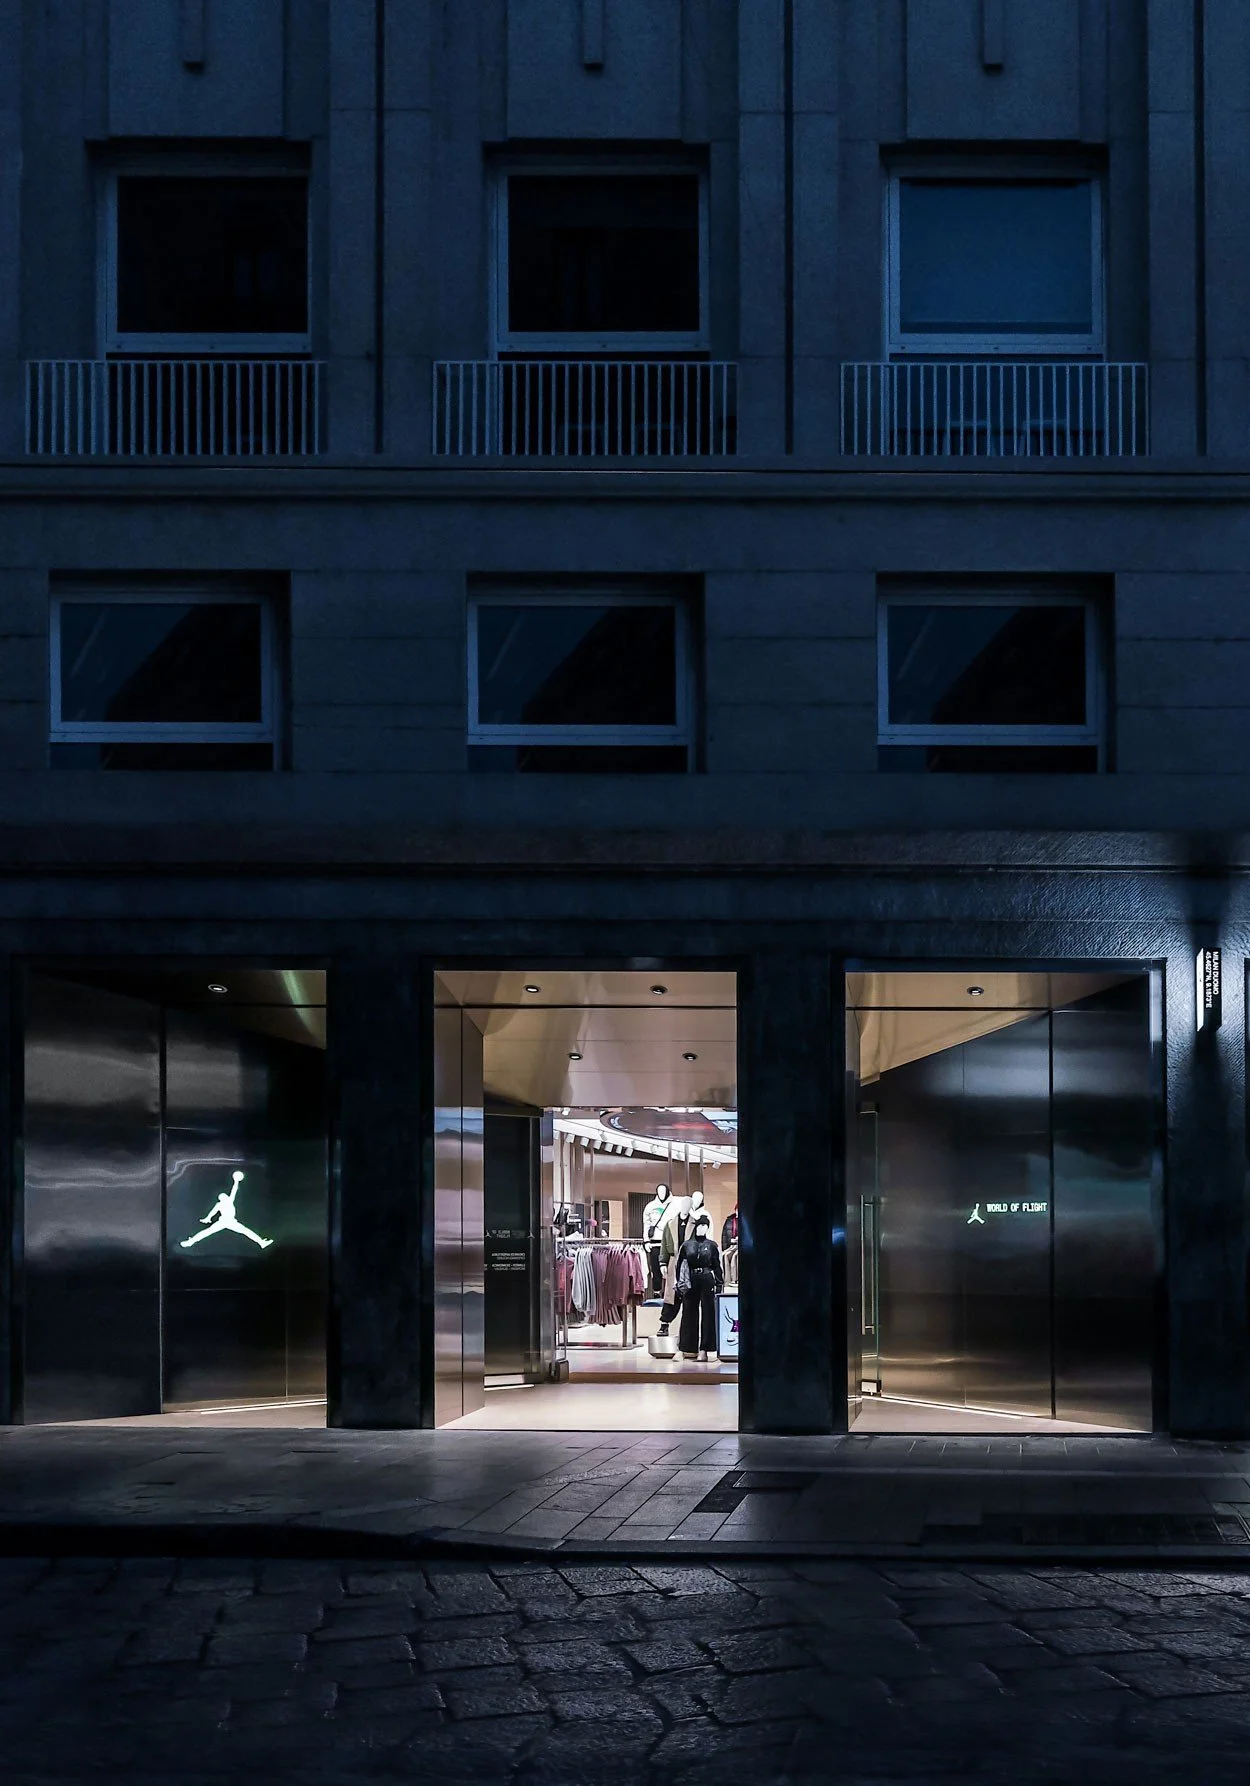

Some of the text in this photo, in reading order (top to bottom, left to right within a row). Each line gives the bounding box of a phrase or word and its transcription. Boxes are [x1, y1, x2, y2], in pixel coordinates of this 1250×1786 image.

[986, 1202, 1048, 1212] WORLD OF FLIGHT
